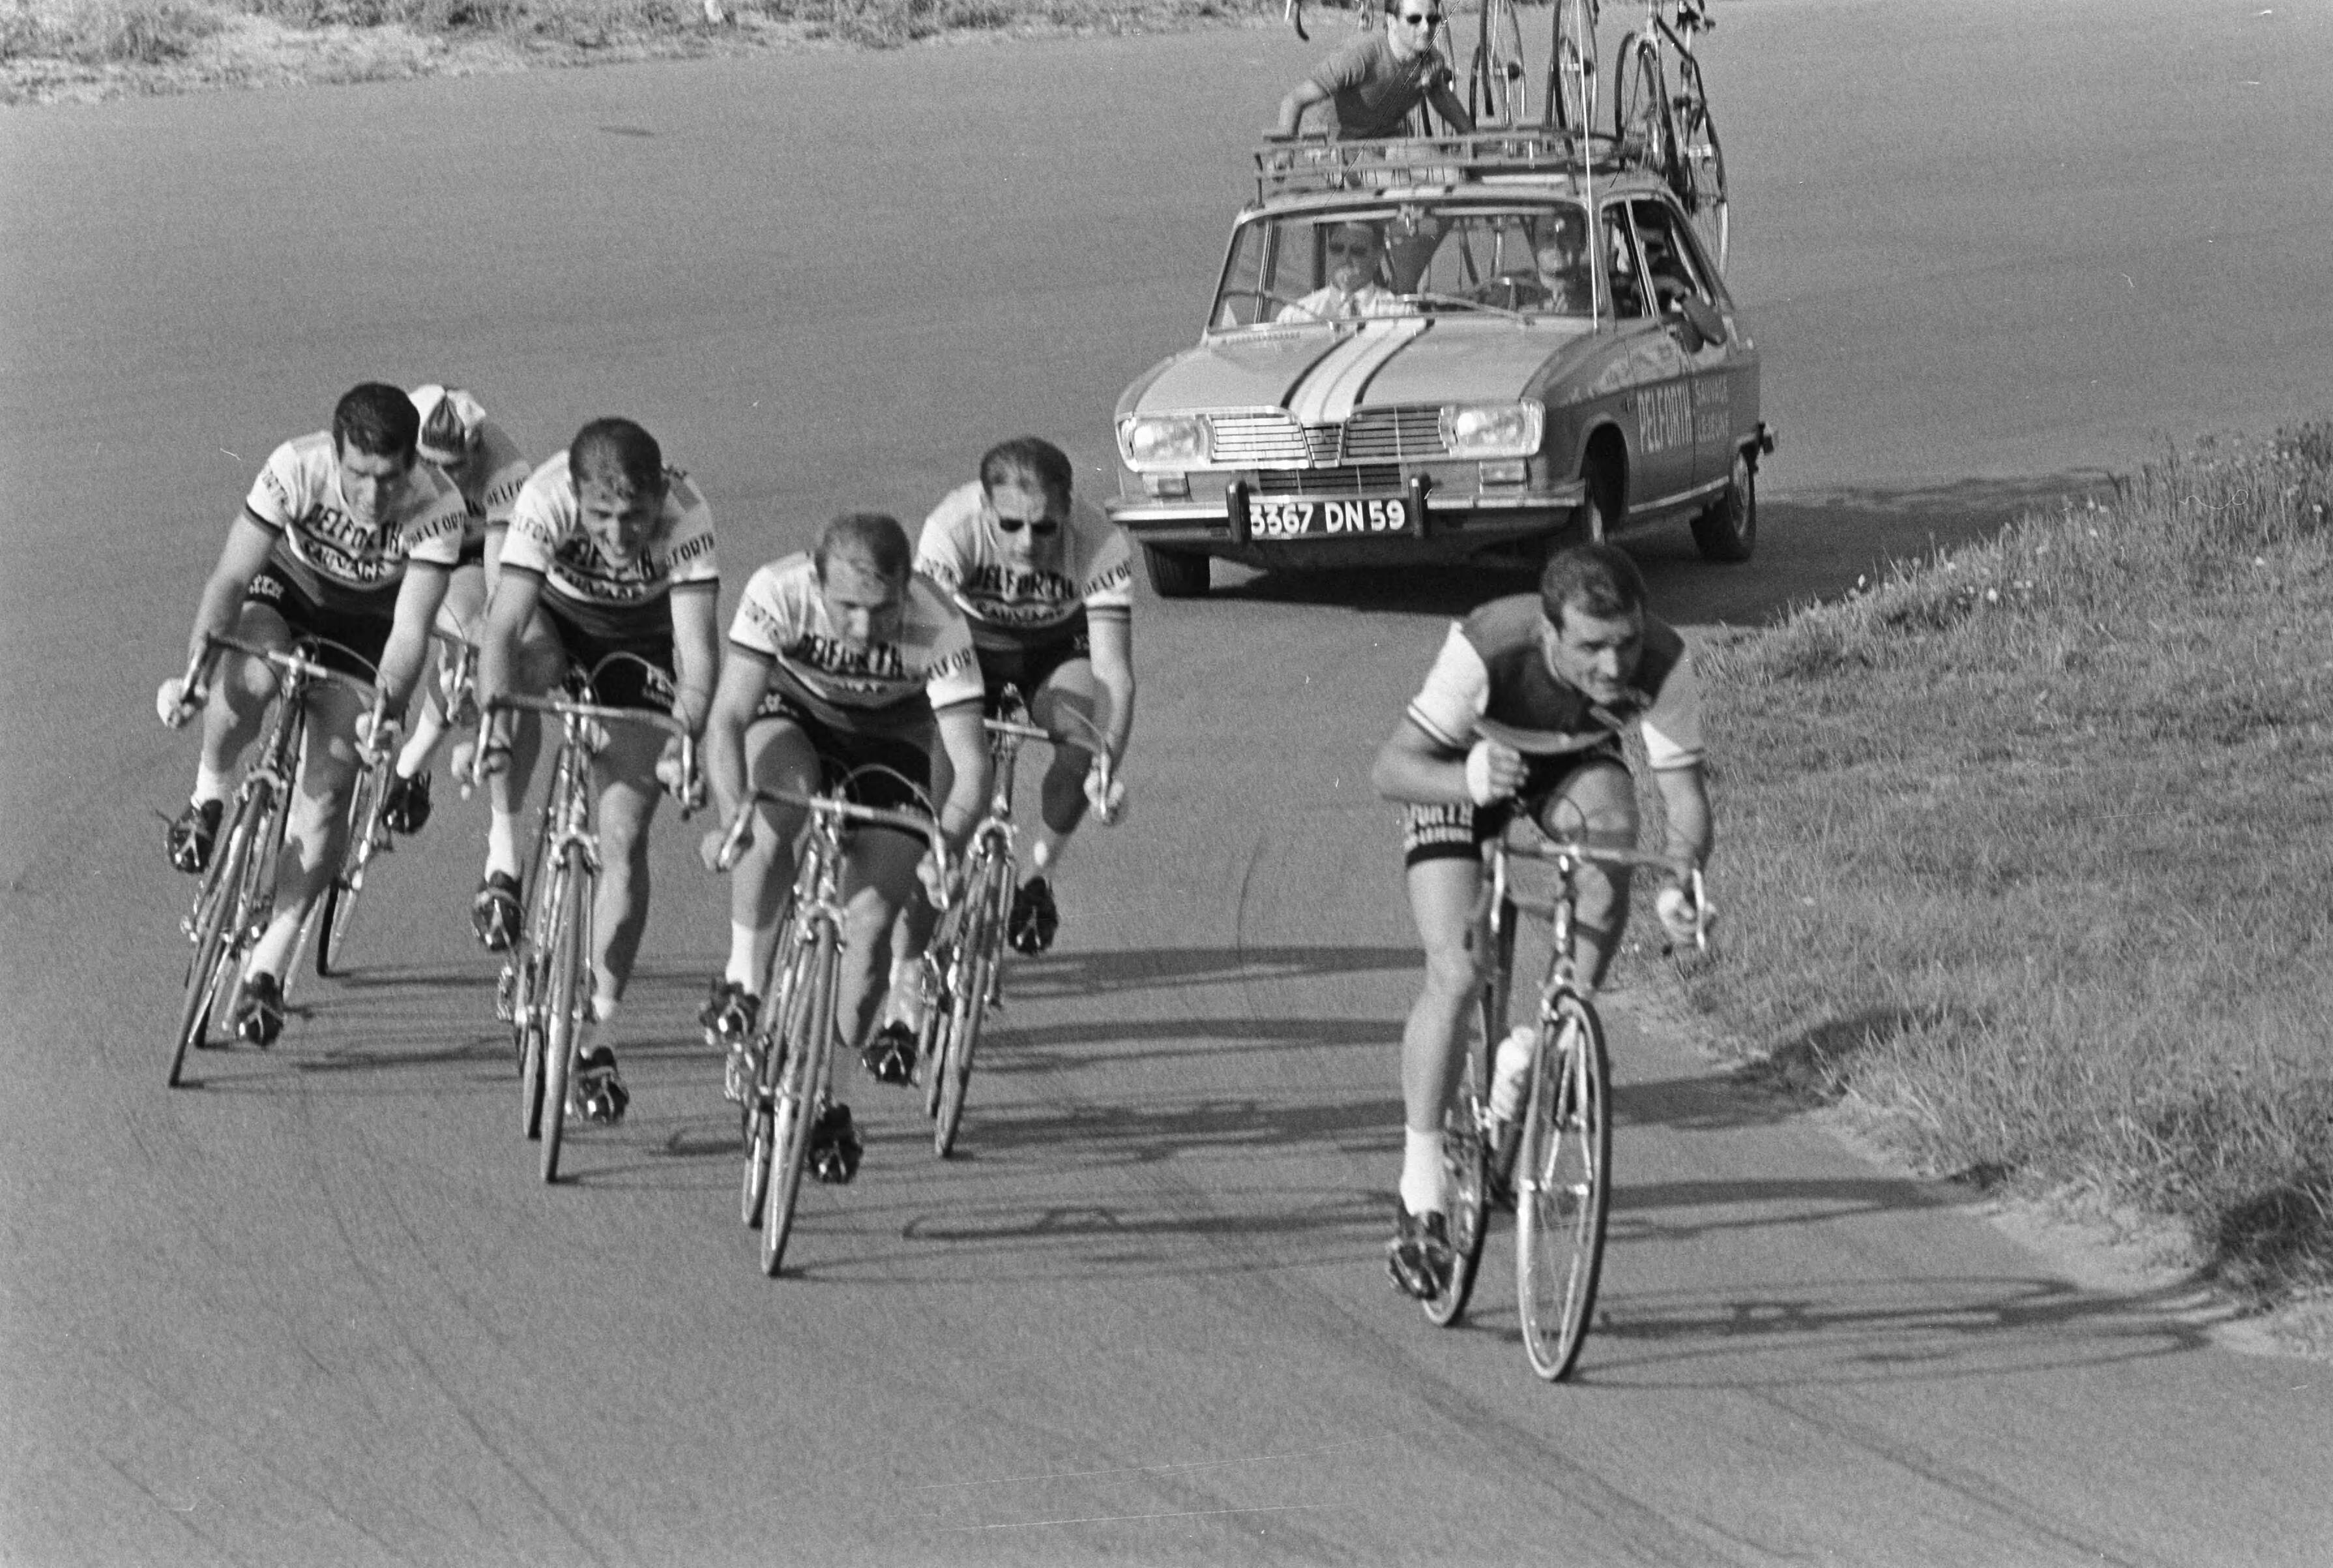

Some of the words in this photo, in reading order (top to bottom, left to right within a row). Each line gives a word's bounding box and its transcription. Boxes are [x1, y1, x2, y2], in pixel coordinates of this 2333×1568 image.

[1637, 382, 1692, 456] PELFORTH
[1325, 501, 1364, 533] DN
[1369, 499, 1405, 531] 59
